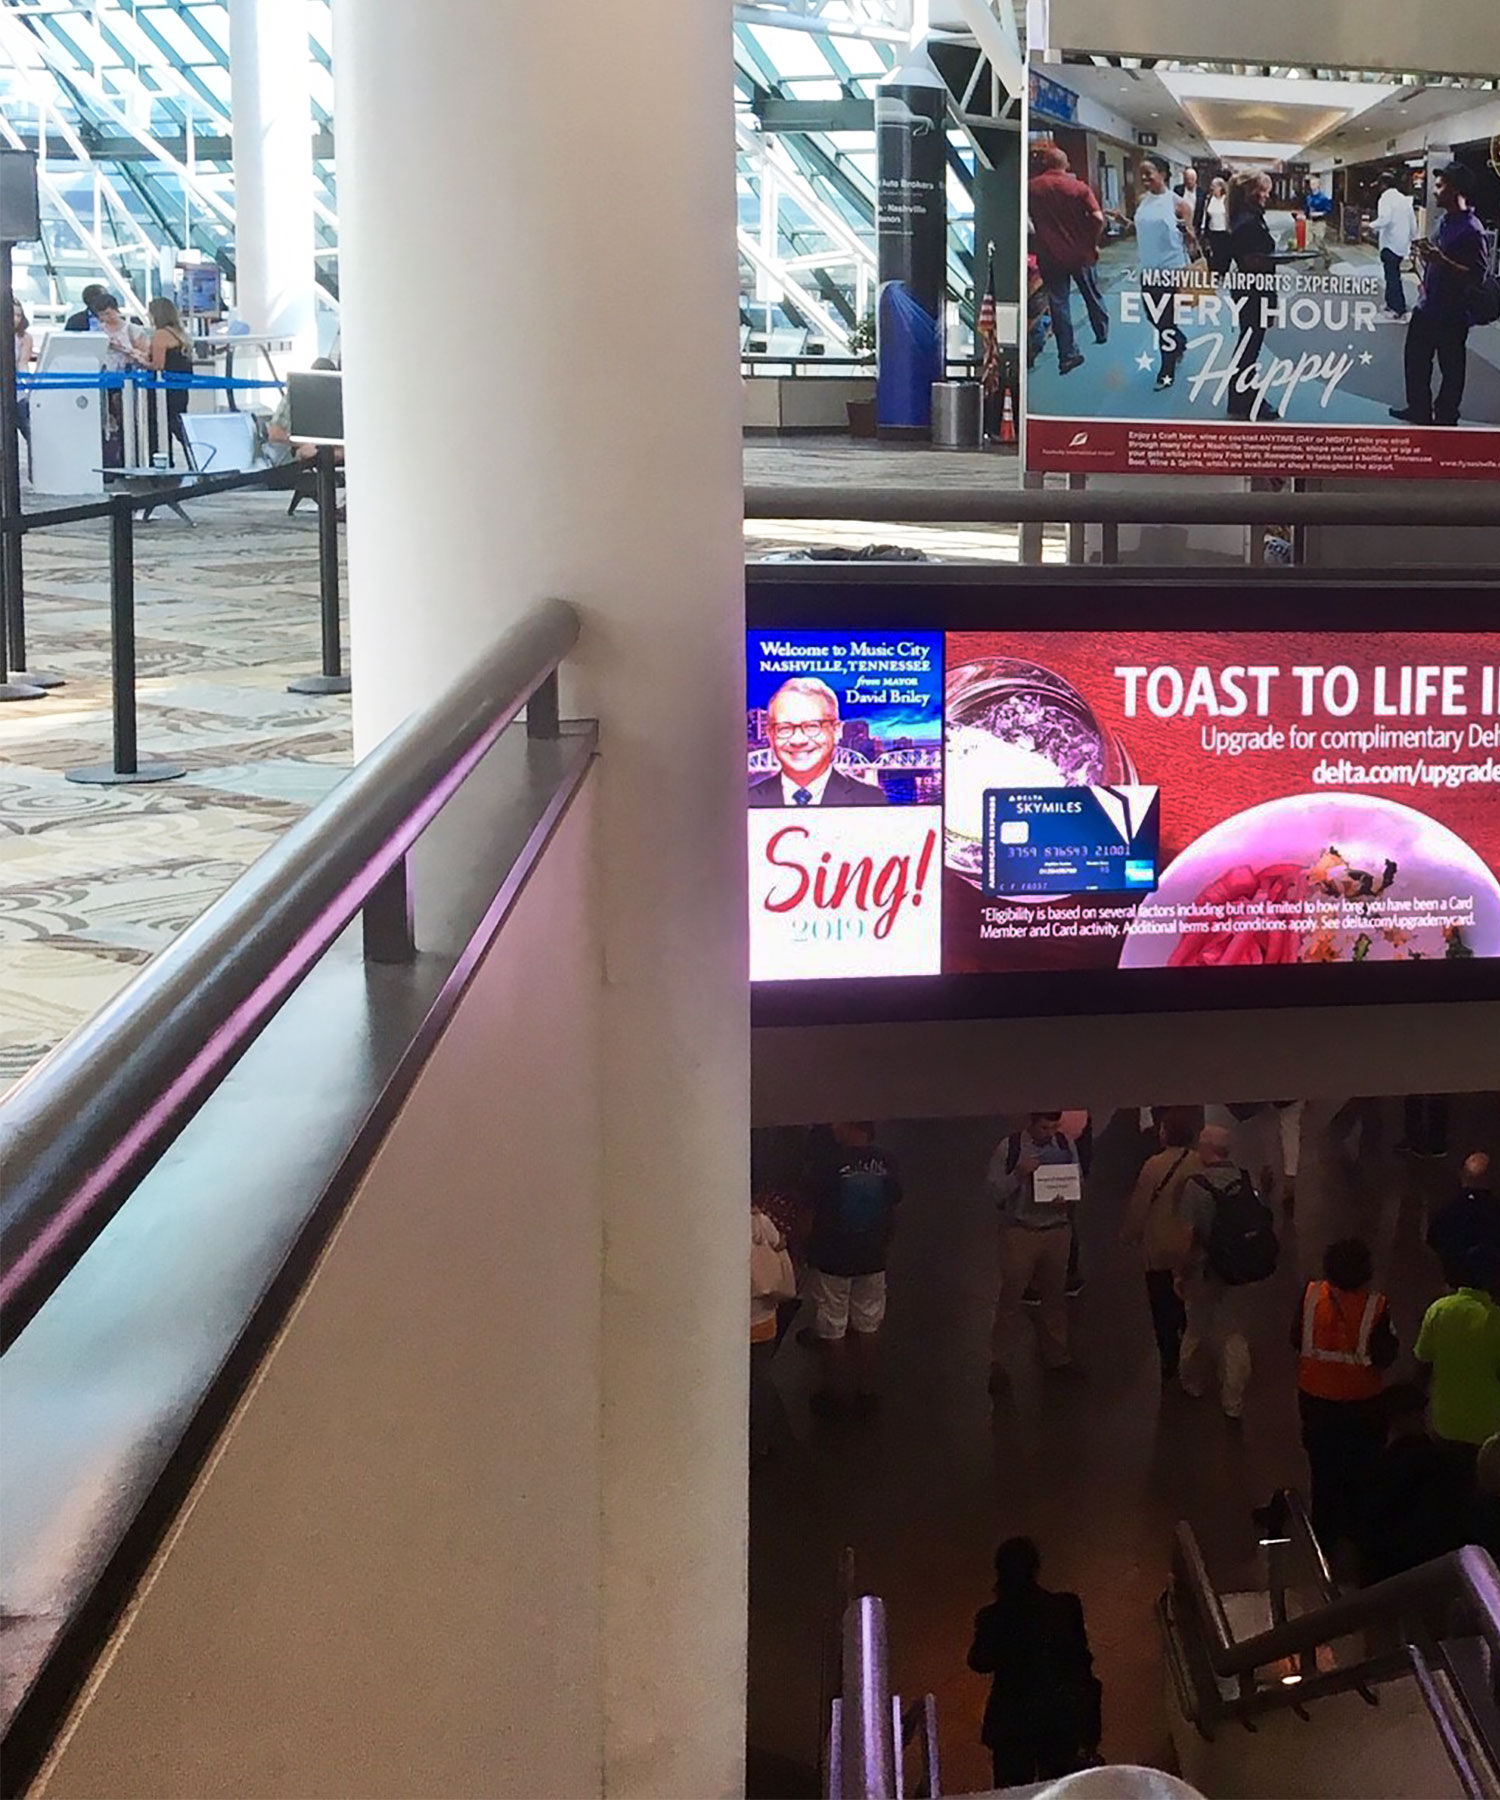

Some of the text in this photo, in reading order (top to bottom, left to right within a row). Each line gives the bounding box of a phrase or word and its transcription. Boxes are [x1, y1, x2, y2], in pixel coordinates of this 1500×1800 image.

[1142, 268, 1218, 288] NASHVILLE
[1223, 271, 1291, 292] AIRPORTS
[1296, 276, 1379, 296] EXPERIENCE
[1120, 292, 1377, 332] EVERY HOUR
[1153, 328, 1177, 352] IS
[1187, 327, 1355, 422] Happy
[1128, 431, 1150, 440] Enjoy
[1158, 432, 1177, 440] Craft
[760, 641, 930, 660] Welcome to Music City
[854, 675, 918, 689] from MAYOR
[1113, 665, 1280, 718] TOAST
[1291, 665, 1360, 717] TO
[1373, 665, 1468, 716] LIFE
[846, 689, 931, 707] David Briley
[1201, 724, 1285, 756] Upgrade
[1289, 723, 1317, 750] for
[1320, 723, 1465, 754] complimentary
[1016, 801, 1083, 814] SKYMILES
[764, 825, 936, 940] Sing!
[1037, 907, 1046, 920] is
[1047, 906, 1080, 920] based
[1082, 908, 1096, 918] on
[1098, 904, 1136, 919] several
[1137, 903, 1174, 918] factors
[1177, 902, 1224, 920] including
[1226, 902, 1244, 914] but
[1246, 901, 1264, 914] not
[1266, 900, 1302, 914] limited
[1304, 901, 1315, 914] to
[1316, 900, 1341, 914] how
[1342, 899, 1365, 916] long
[1366, 900, 1386, 917] you
[1386, 898, 1412, 912] have
[1413, 897, 1439, 911] been
[1440, 899, 1448, 910] a
[1449, 896, 1473, 910] Card
[792, 917, 865, 942] 2019
[980, 911, 1476, 939] Member and Card activity. Additional terms and conditions apply. See delta.com/upgrademycard.
